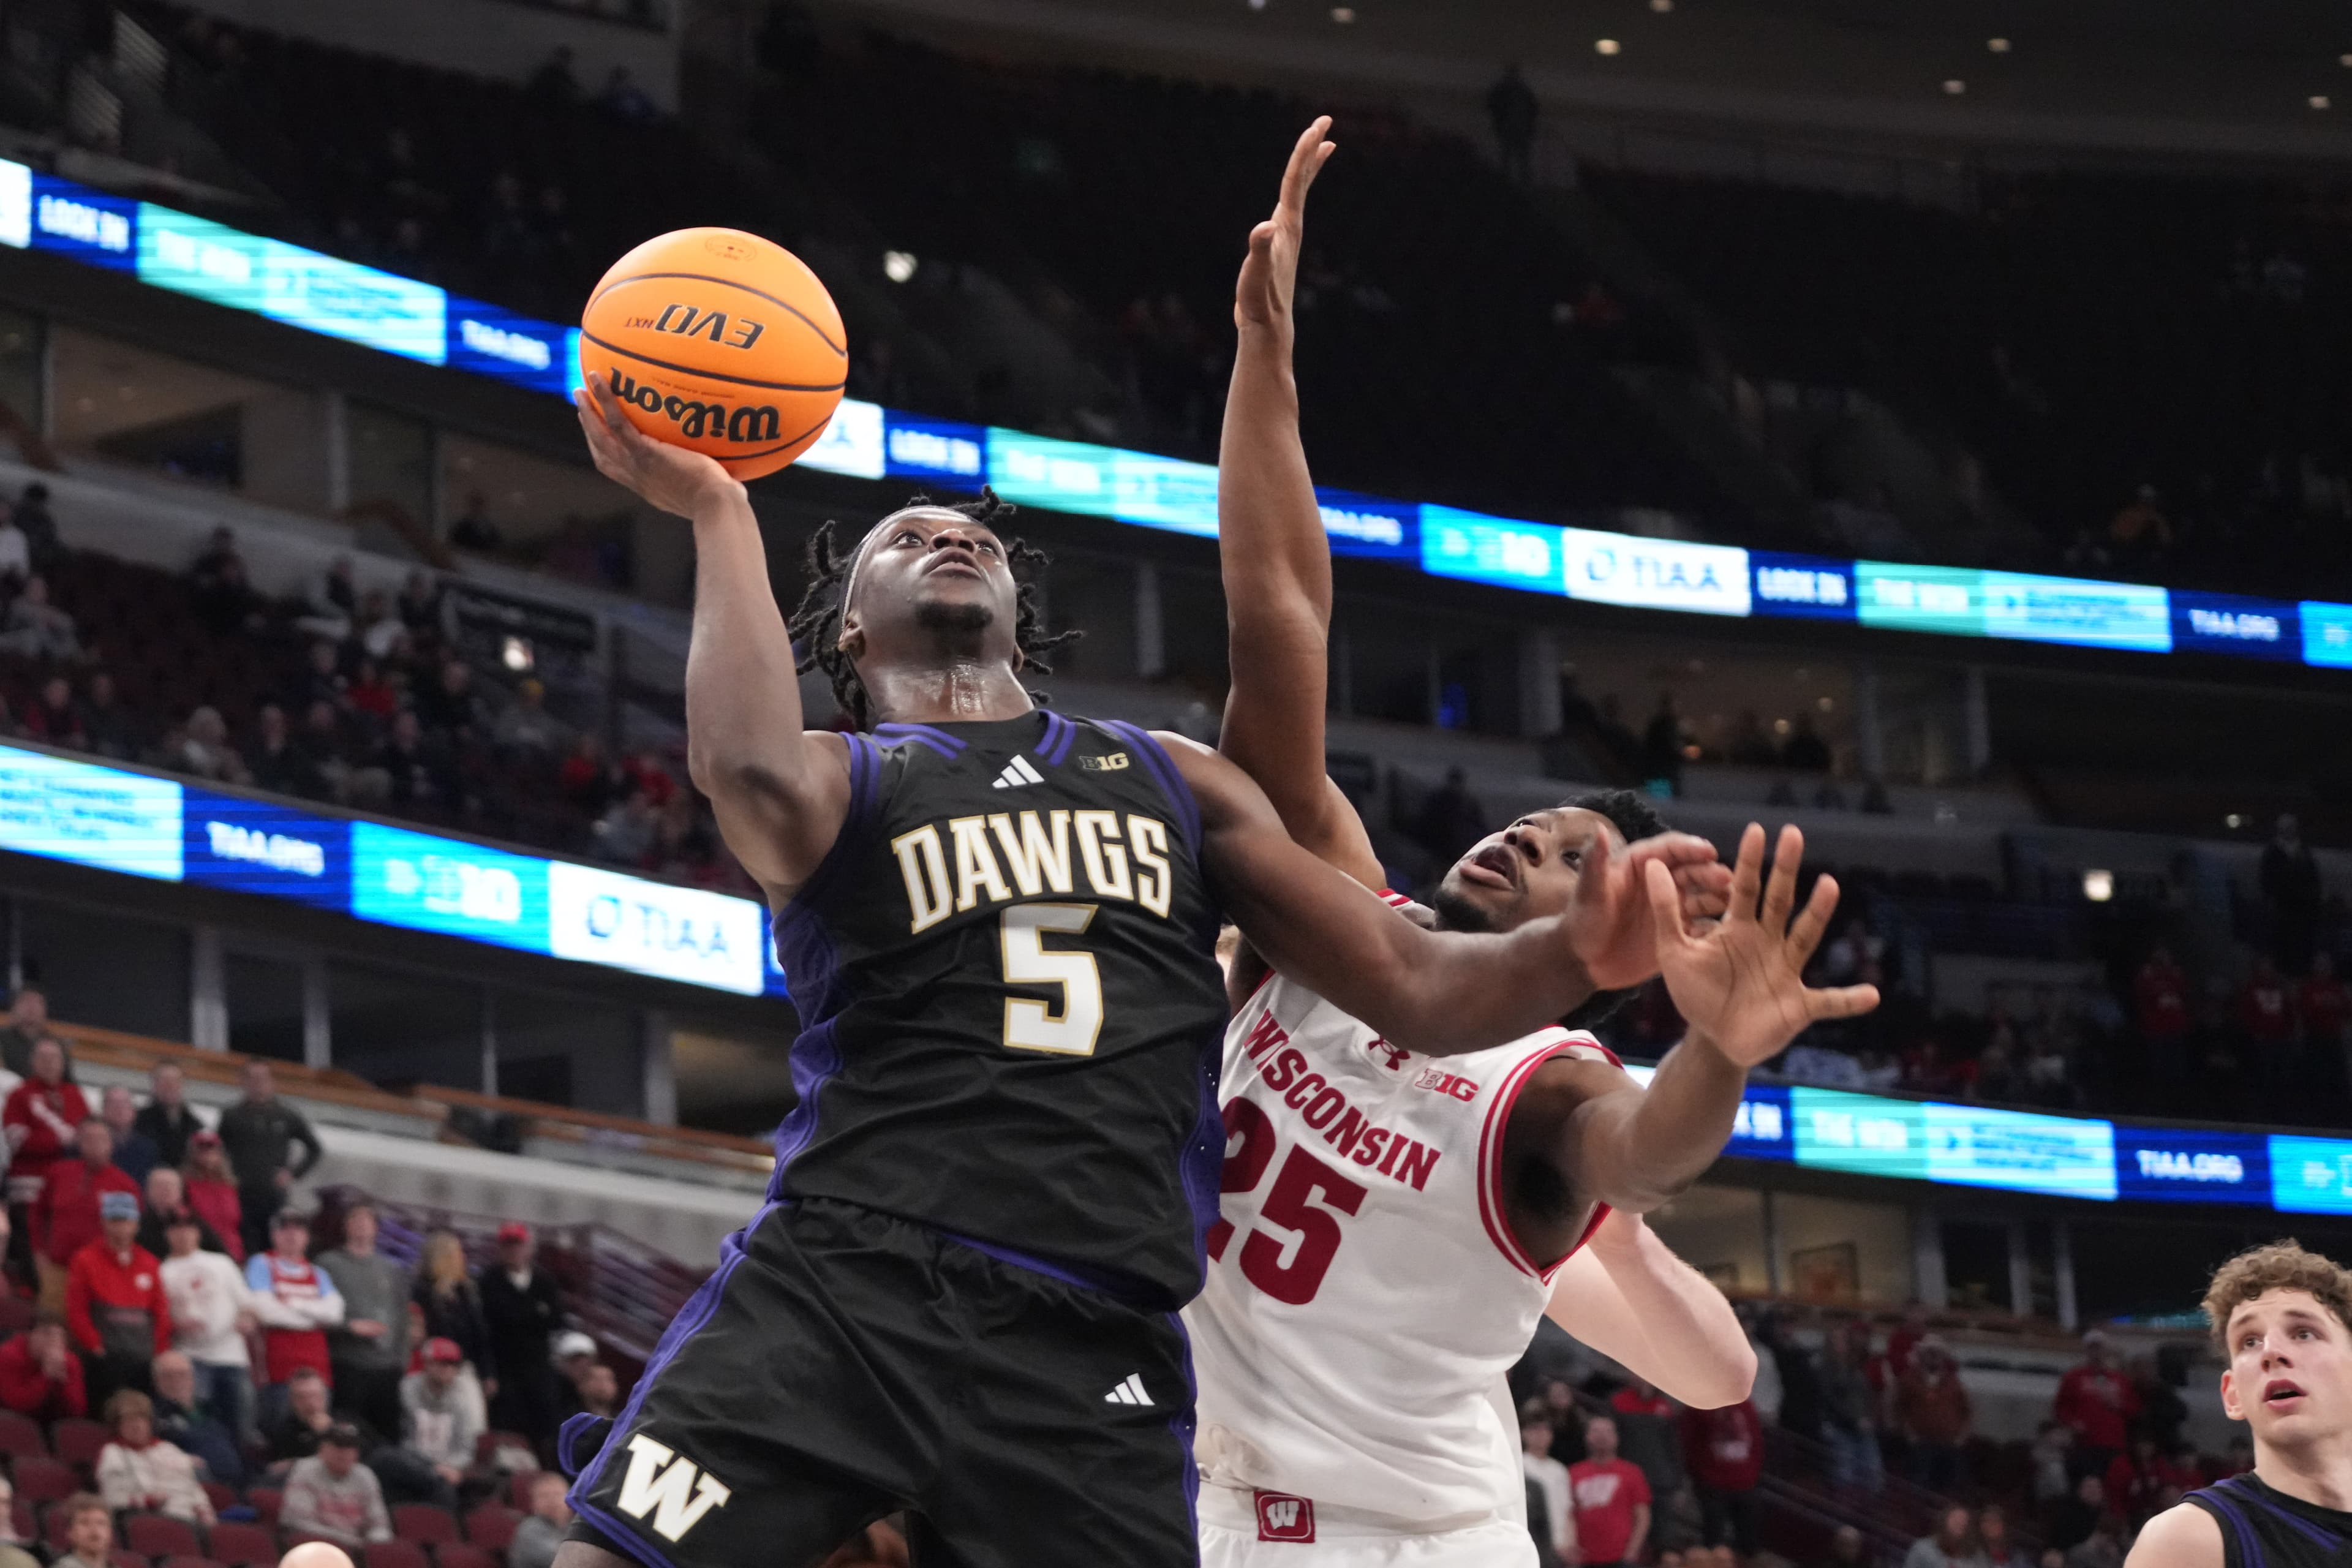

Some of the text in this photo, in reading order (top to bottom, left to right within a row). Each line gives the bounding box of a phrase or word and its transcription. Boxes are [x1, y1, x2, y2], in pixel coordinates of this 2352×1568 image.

[624, 302, 766, 350] EVO NXT
[610, 368, 781, 442] Wilson
[1631, 554, 1723, 592] TIAA
[890, 810, 1172, 935] DAWGS
[636, 903, 734, 963] TIAA
[1000, 902, 1104, 1056] 5
[1243, 1008, 1442, 1192] WISCONSIN
[1206, 1095, 1368, 1305] 25
[617, 1433, 732, 1543] W
[1266, 1500, 1300, 1530] W
